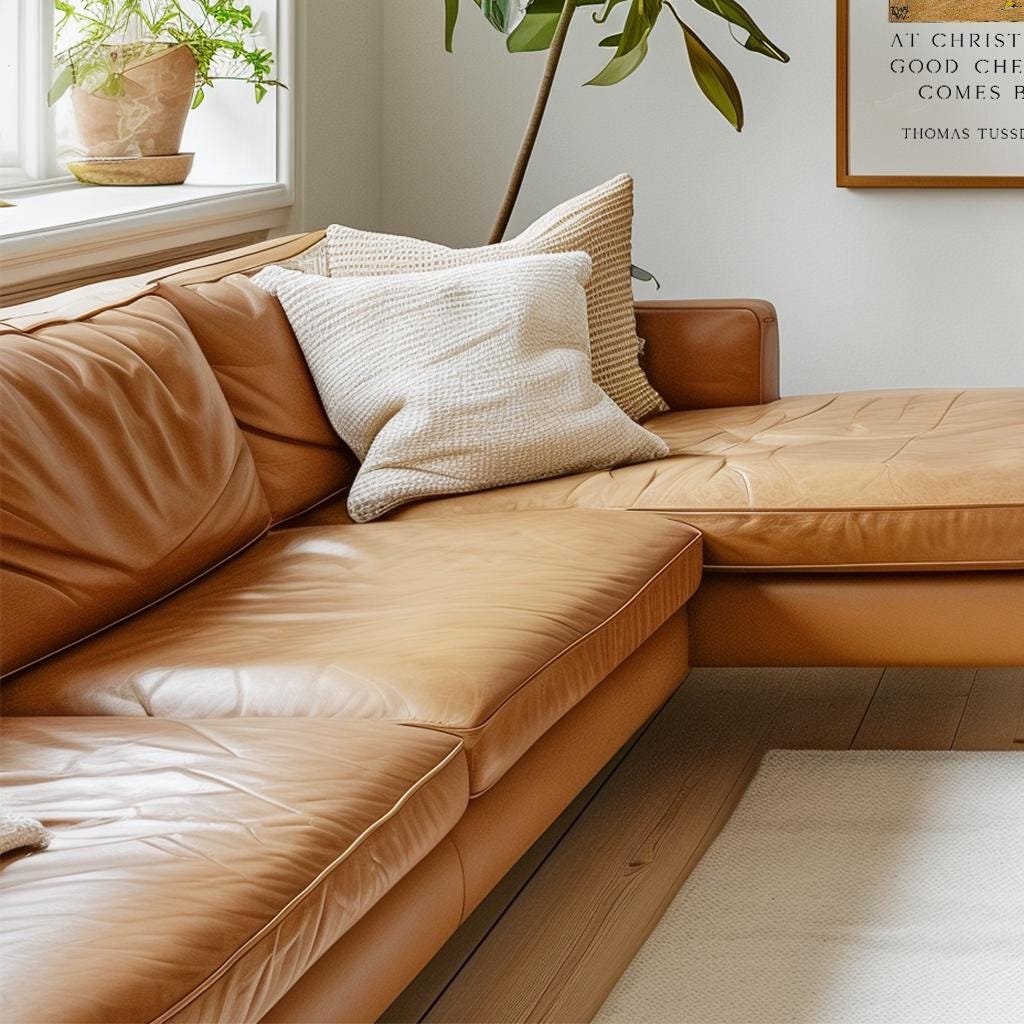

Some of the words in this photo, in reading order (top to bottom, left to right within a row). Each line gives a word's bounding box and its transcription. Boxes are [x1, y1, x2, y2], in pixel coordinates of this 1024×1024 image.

[890, 32, 919, 48] AT
[890, 58, 958, 74] GOOD
[918, 84, 1000, 100] COMES
[901, 127, 970, 140] THOMAS
